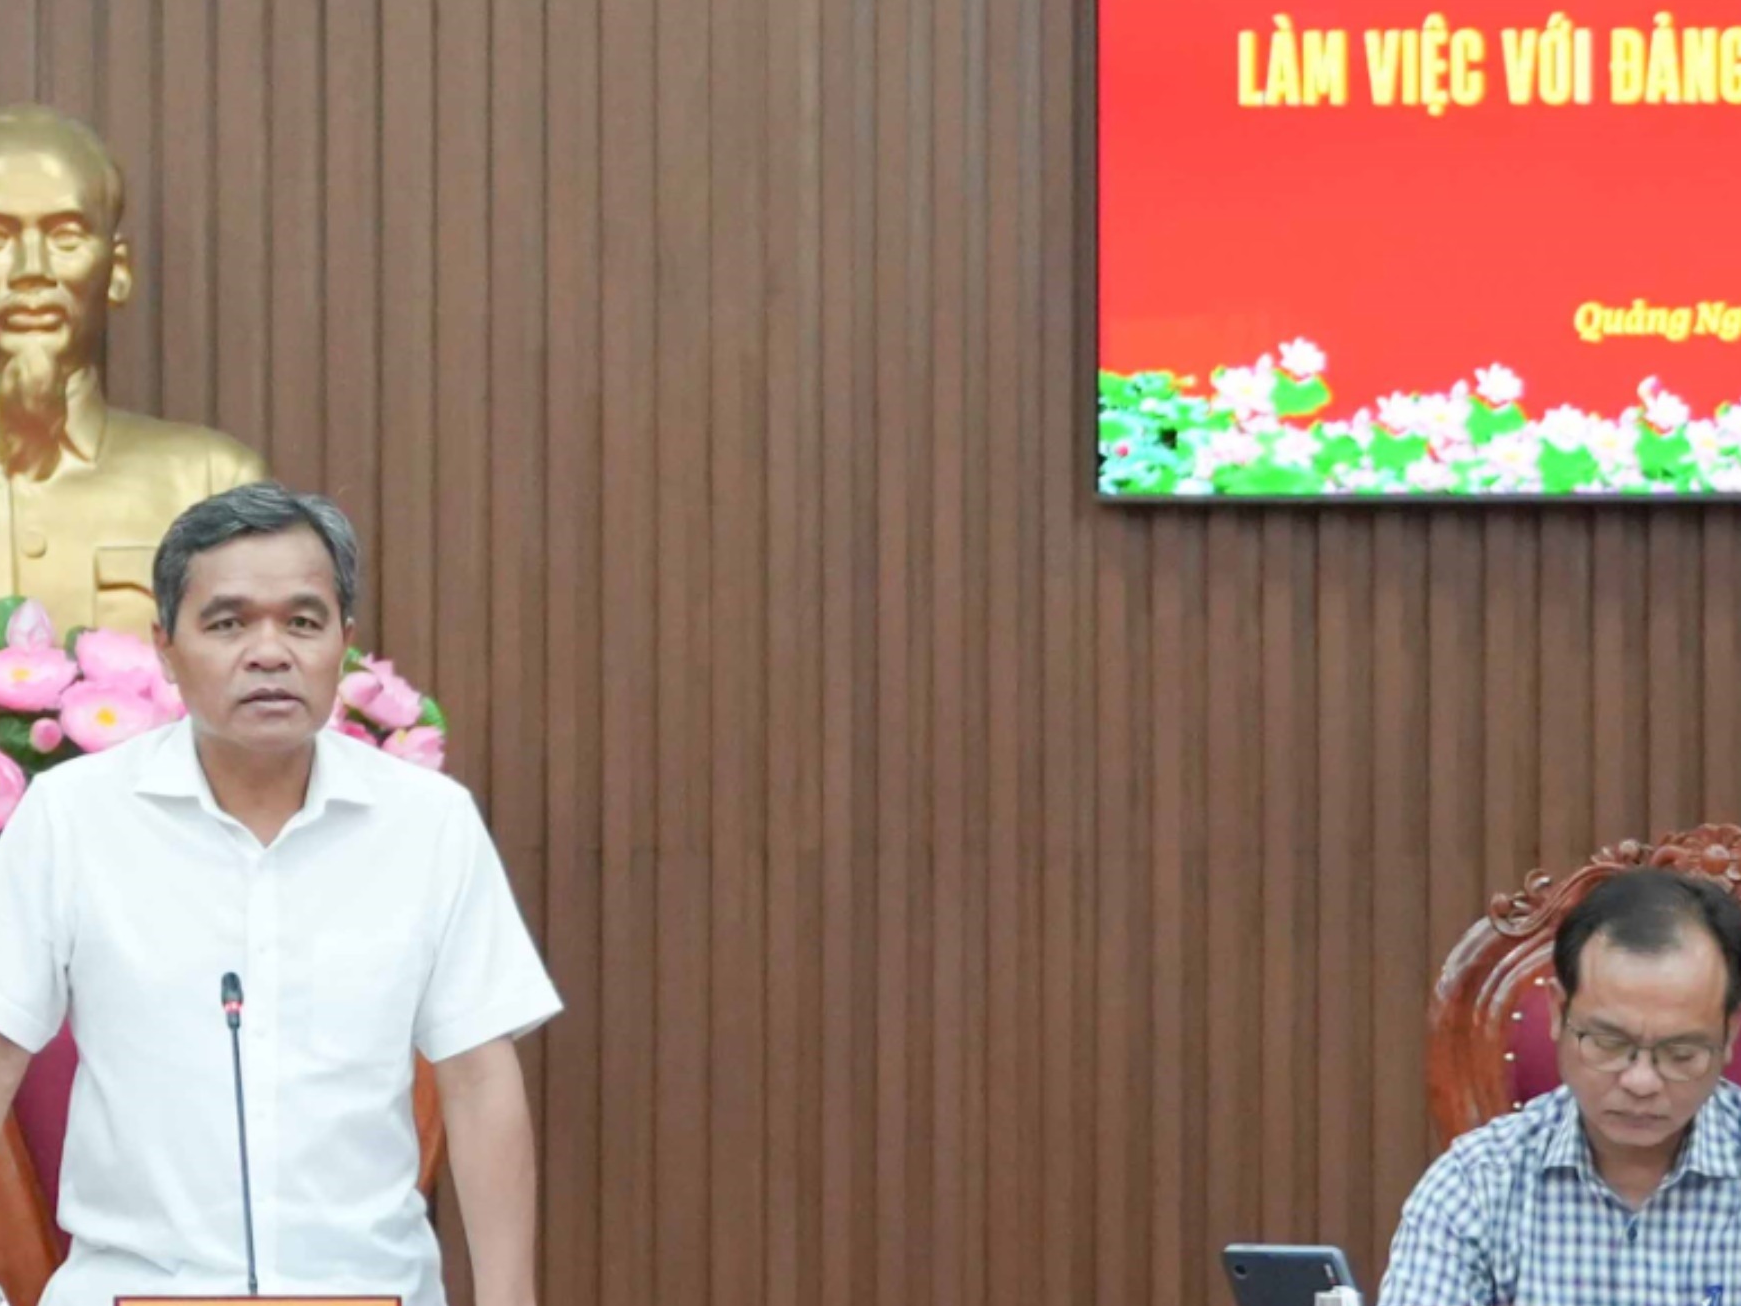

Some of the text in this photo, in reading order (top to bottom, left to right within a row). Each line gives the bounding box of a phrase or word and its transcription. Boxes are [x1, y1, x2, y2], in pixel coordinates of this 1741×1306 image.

[1237, 13, 1347, 106] LÀM
[1364, 13, 1485, 117] VIỆC
[1502, 11, 1592, 105] VỚI
[1574, 298, 1691, 342] Quảng
